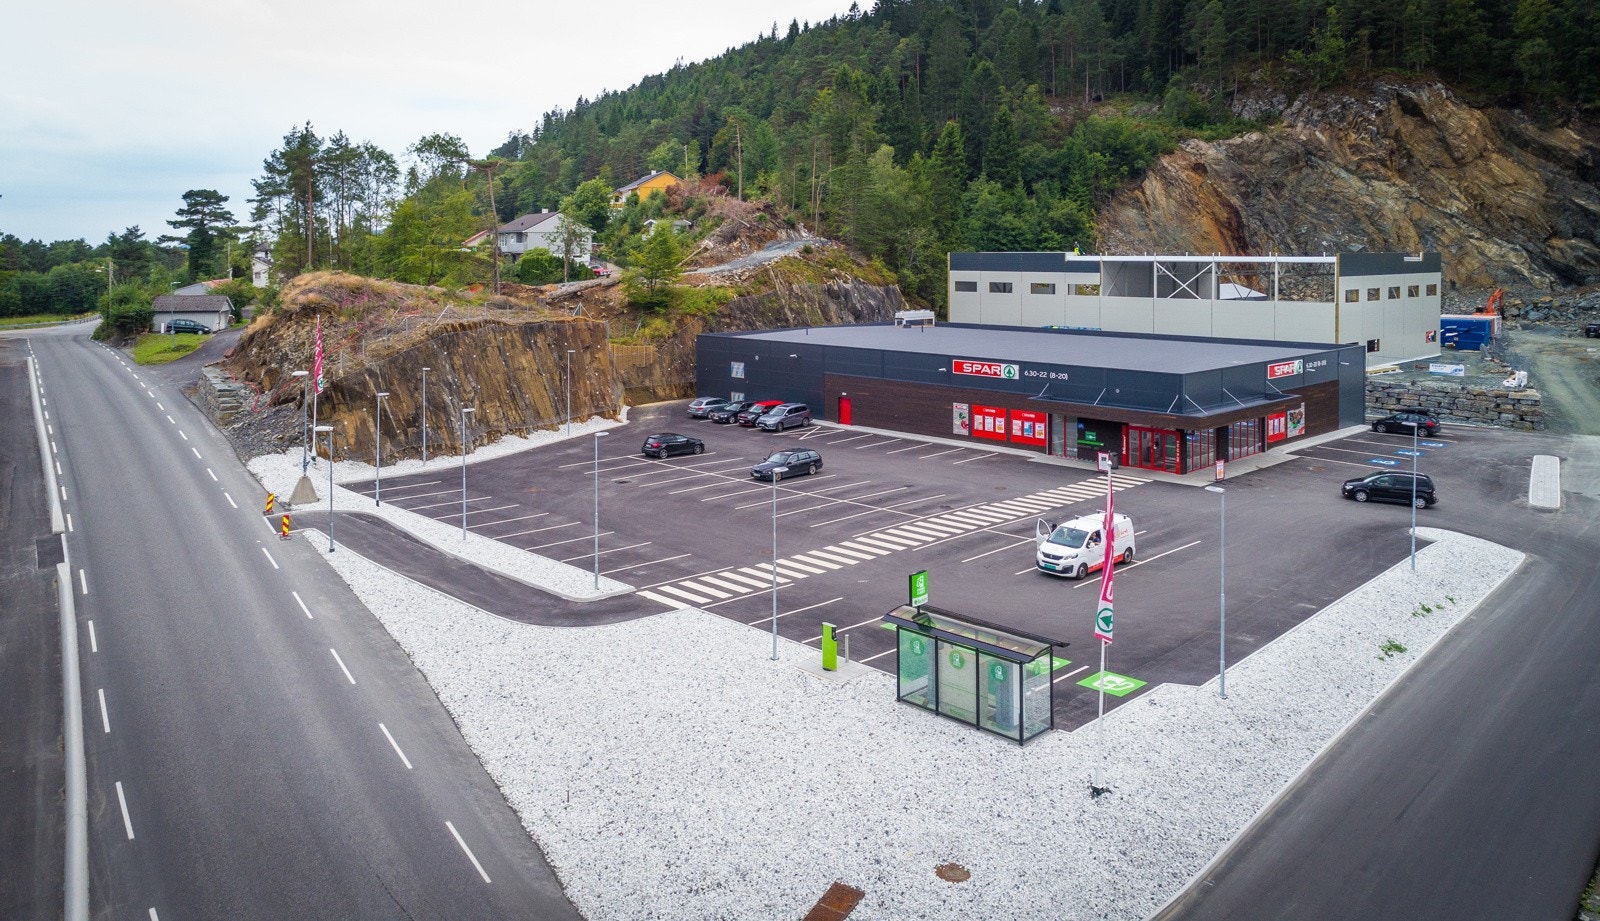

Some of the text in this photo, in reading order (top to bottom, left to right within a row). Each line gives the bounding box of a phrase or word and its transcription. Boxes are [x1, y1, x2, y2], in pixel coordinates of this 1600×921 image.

[963, 363, 1001, 375] SPAR
[1274, 364, 1294, 375] SPAR
[1024, 370, 1068, 380] 6.30-22 (8-20)
